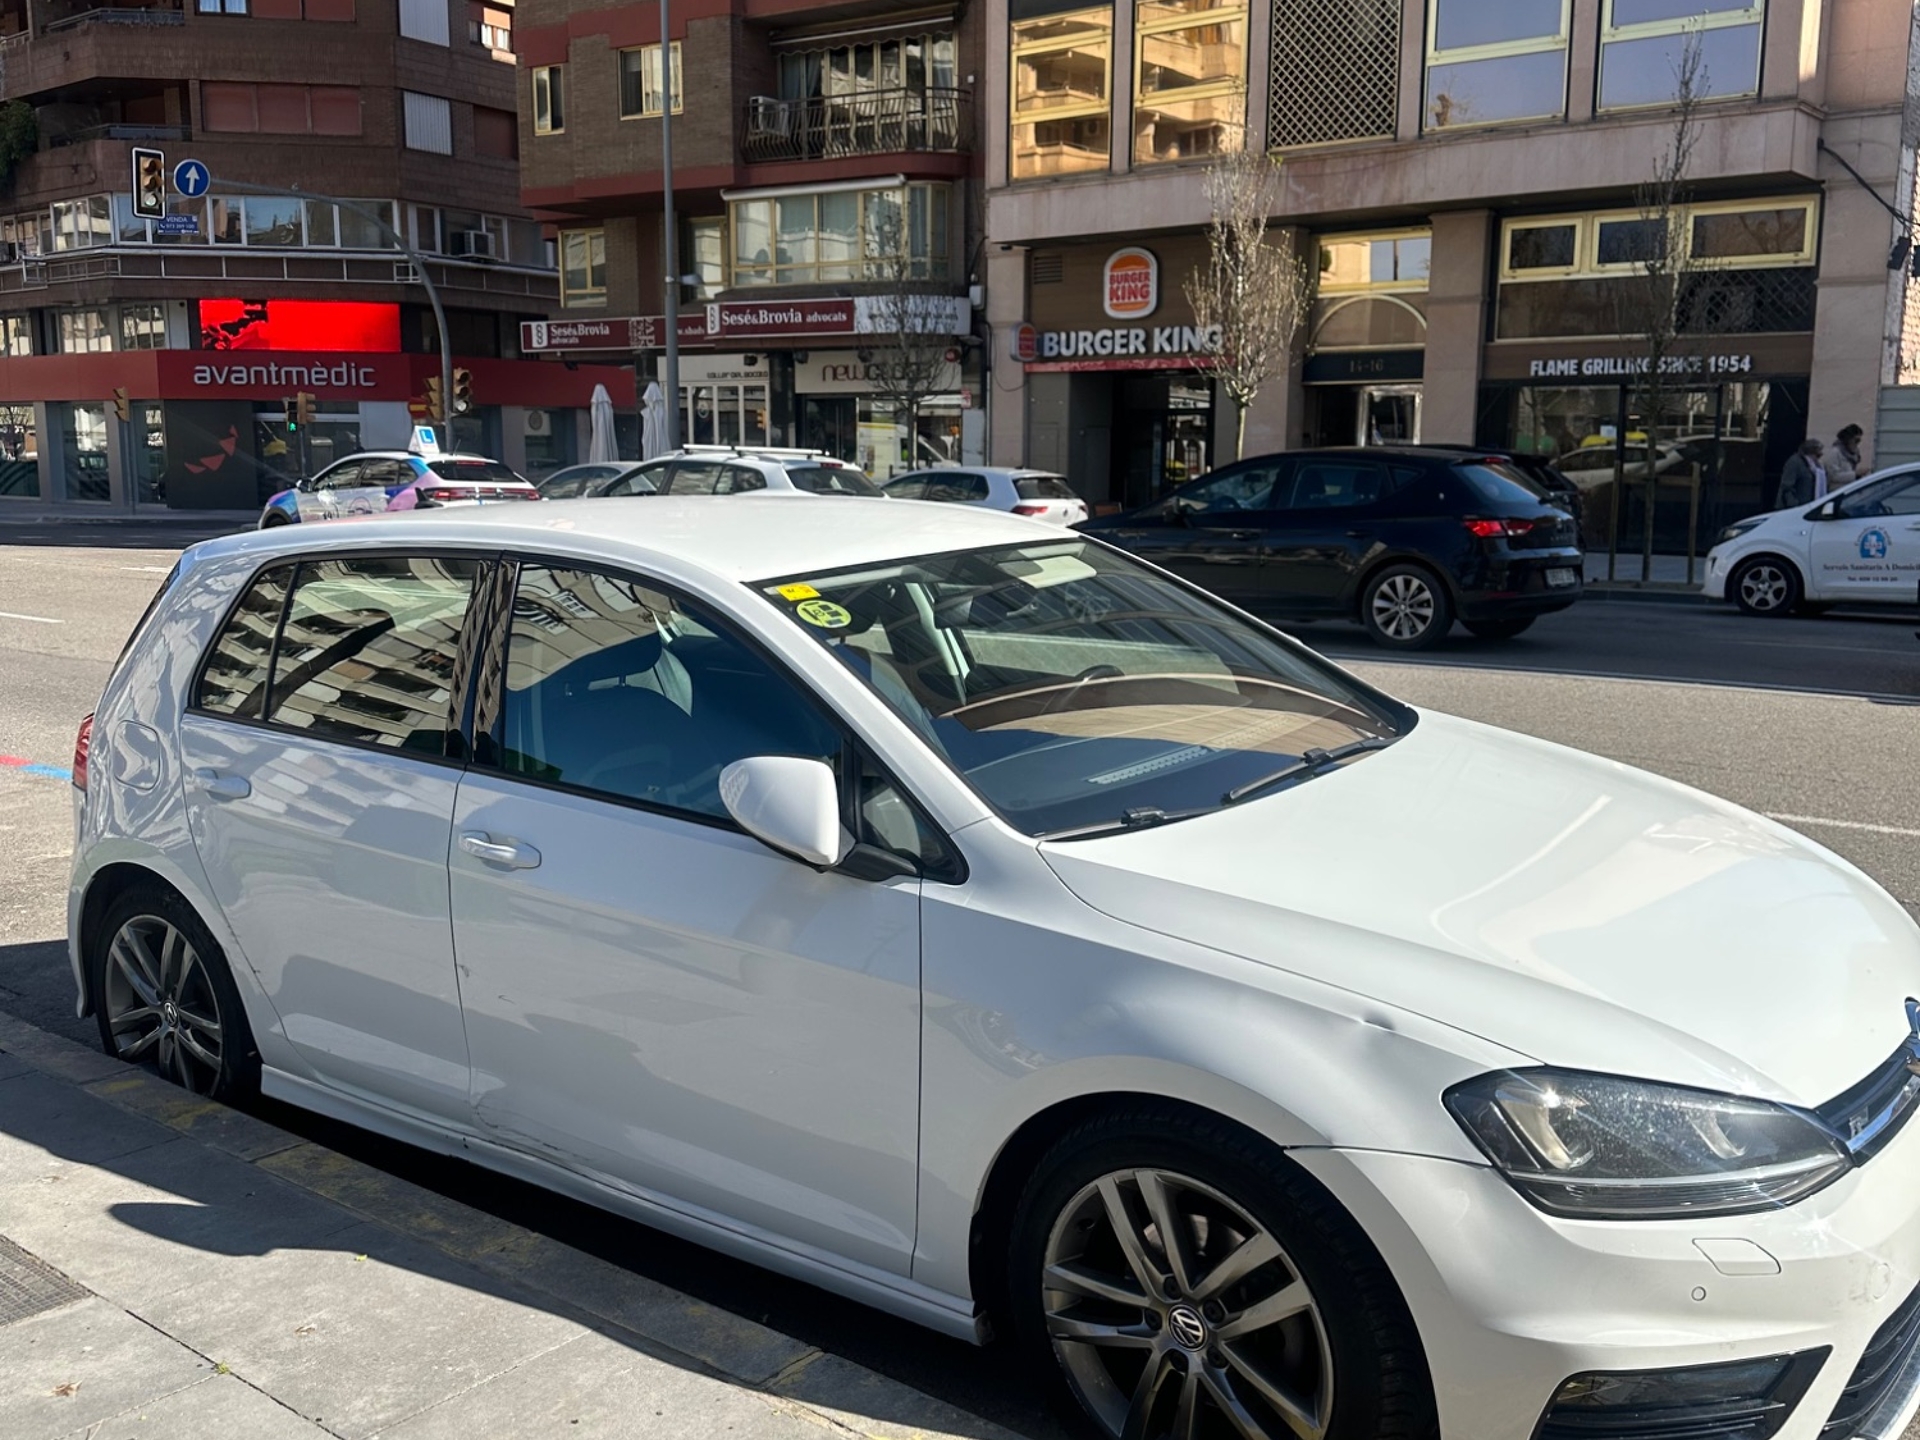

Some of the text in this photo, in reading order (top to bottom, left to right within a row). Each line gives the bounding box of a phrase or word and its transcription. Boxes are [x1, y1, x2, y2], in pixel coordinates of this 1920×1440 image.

[1109, 271, 1151, 285] BURGER
[1109, 283, 1150, 301] KING
[721, 308, 848, 325] Sesé&Brovia advocats
[1043, 328, 1146, 357] BURGER
[1153, 324, 1223, 355] KING
[193, 361, 377, 386] avantmèdic
[1530, 354, 1752, 377] FLAME GRILLING SINCE 1954
